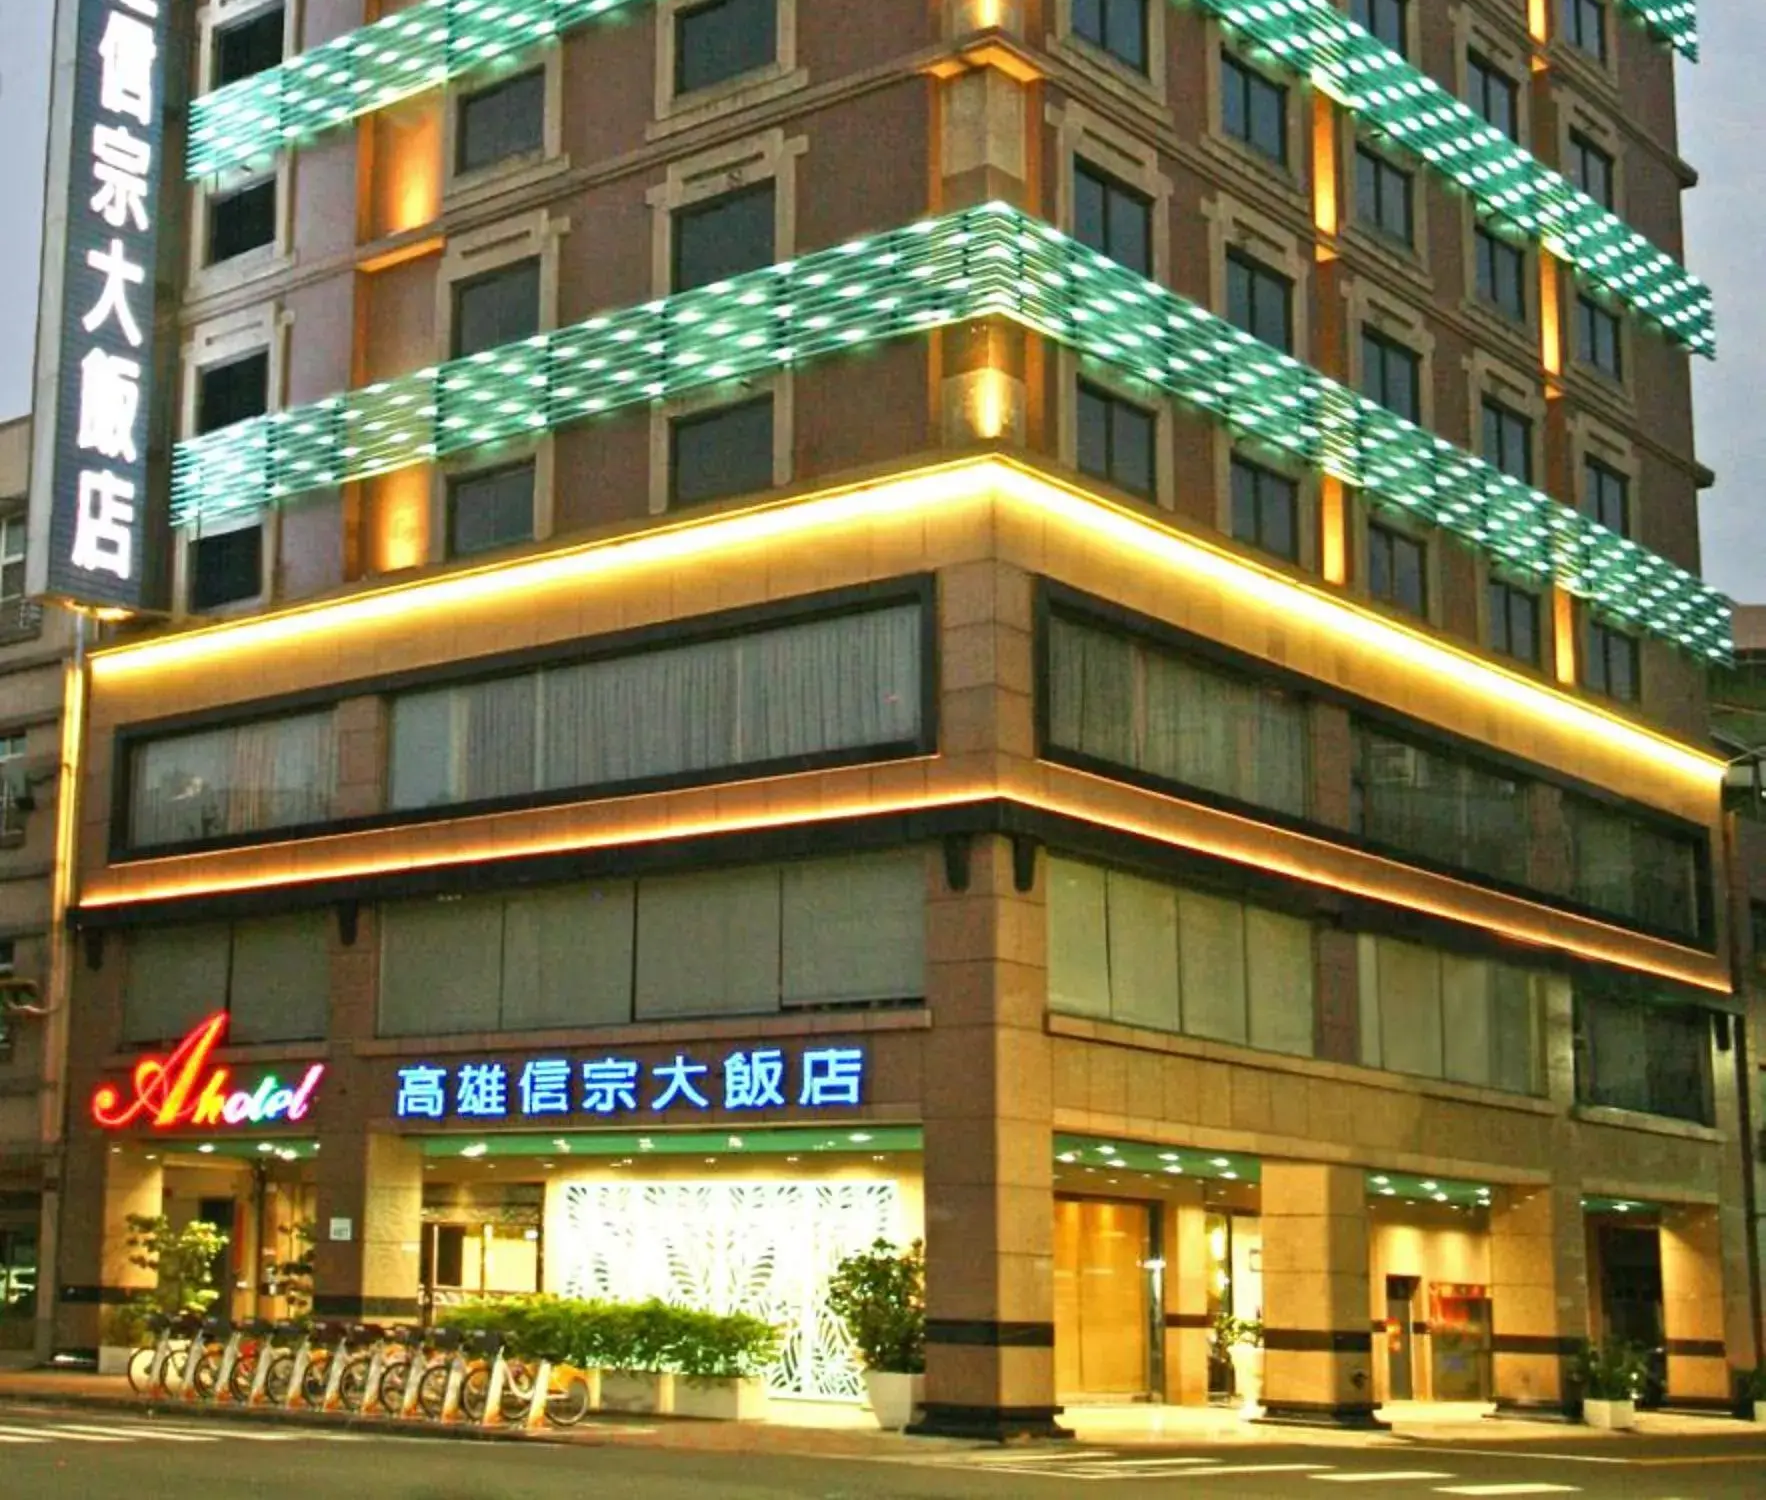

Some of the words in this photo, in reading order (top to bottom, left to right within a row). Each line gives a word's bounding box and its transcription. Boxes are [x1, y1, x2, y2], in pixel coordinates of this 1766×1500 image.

[397, 1048, 862, 1116] 高雄信宗大飯店
